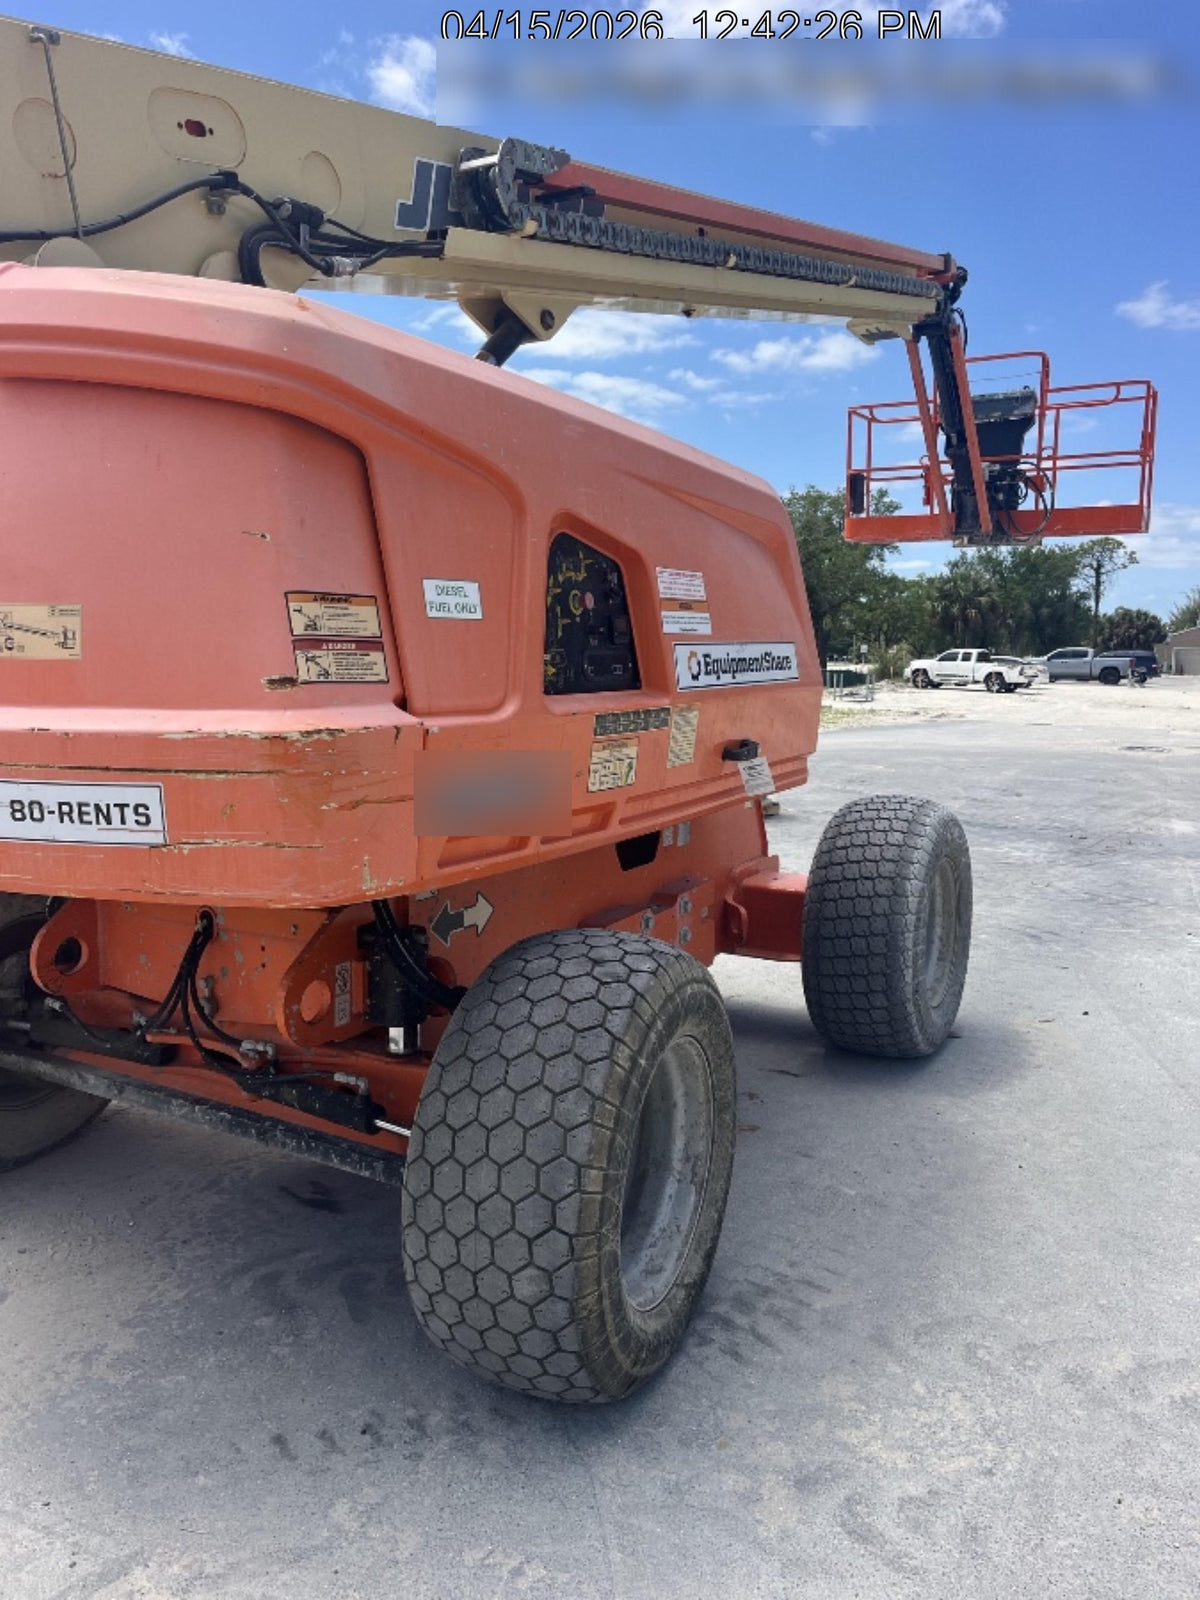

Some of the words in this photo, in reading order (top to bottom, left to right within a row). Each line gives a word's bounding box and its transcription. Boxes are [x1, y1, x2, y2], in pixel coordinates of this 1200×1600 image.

[434, 584, 470, 598] DIESEL
[428, 600, 453, 613] FUEL
[454, 602, 478, 614] ONLY
[702, 651, 793, 681] EquipmentShare
[9, 798, 152, 828] 80-RENTS
